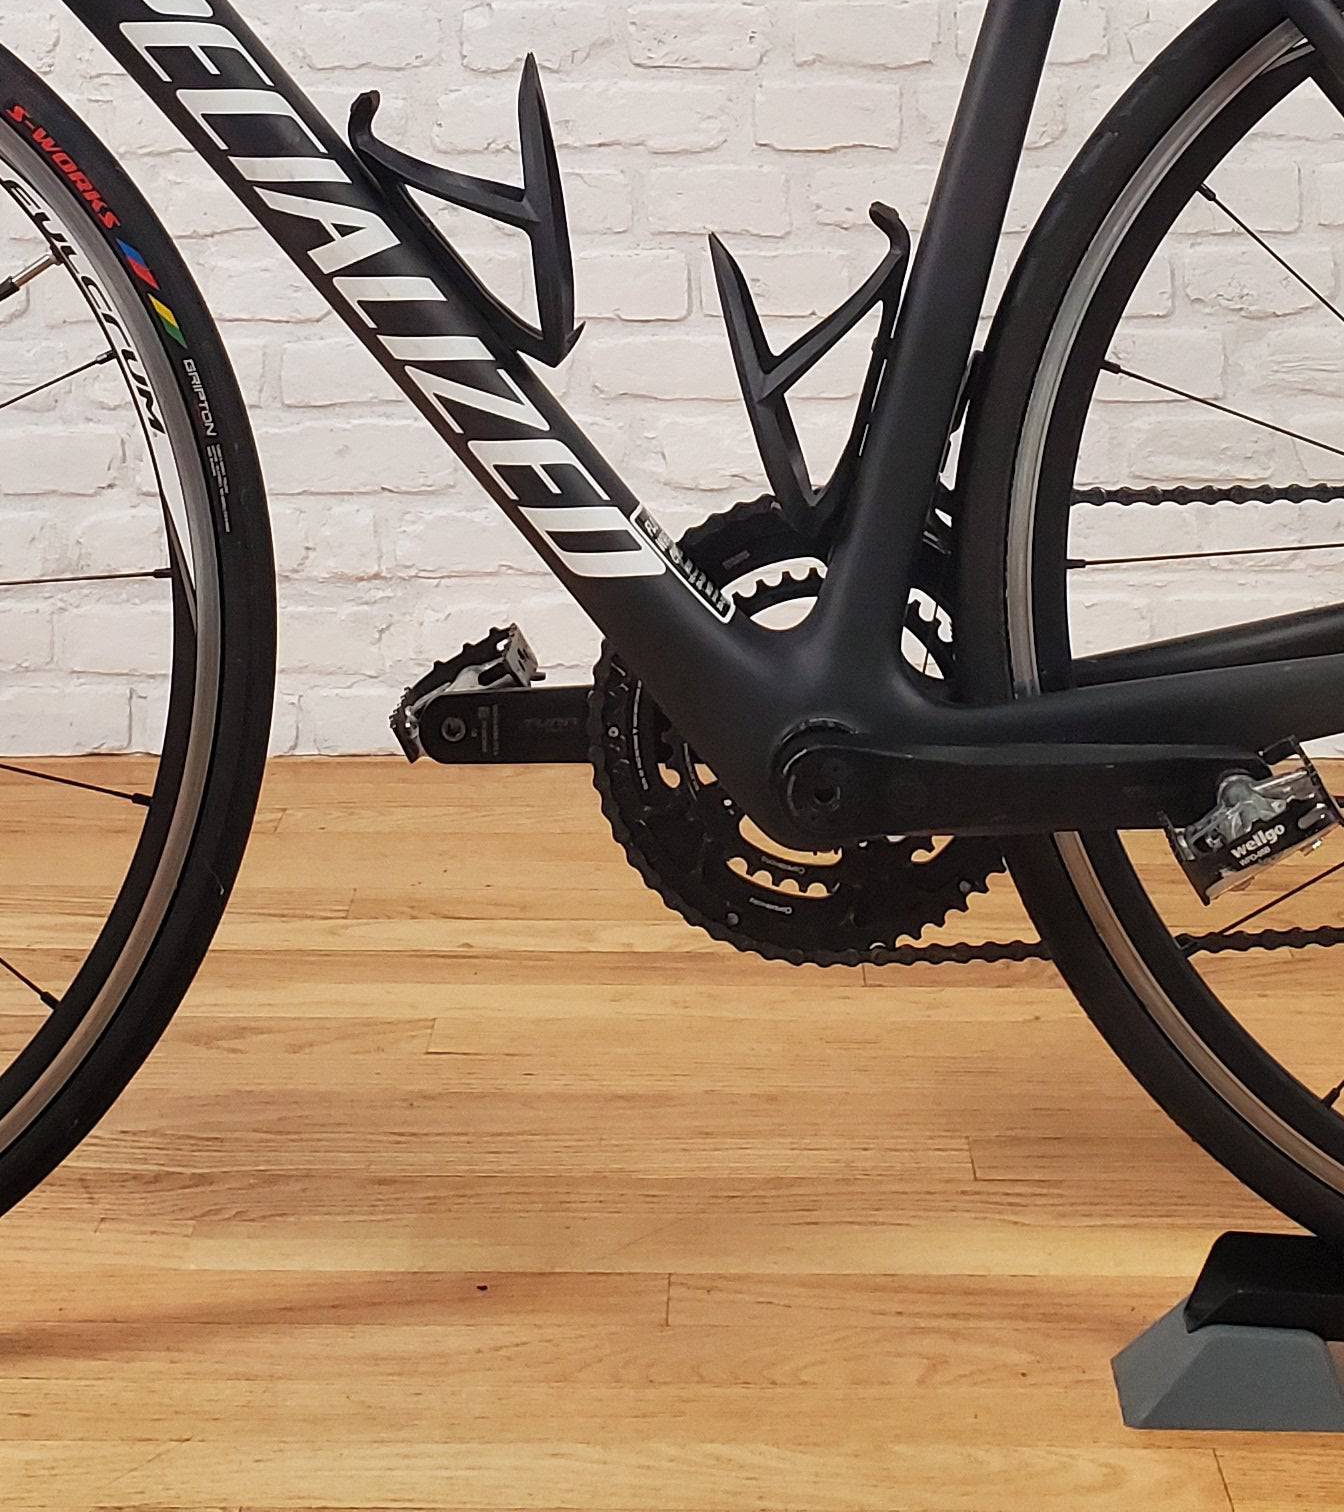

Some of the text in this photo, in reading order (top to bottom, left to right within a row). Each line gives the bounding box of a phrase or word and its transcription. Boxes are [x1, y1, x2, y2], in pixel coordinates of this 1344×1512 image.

[6, 104, 120, 230] S-WORKS
[4, 179, 166, 436] FULCRUM
[183, 358, 216, 436] GRIPTON
[1230, 824, 1286, 858] wellgo
